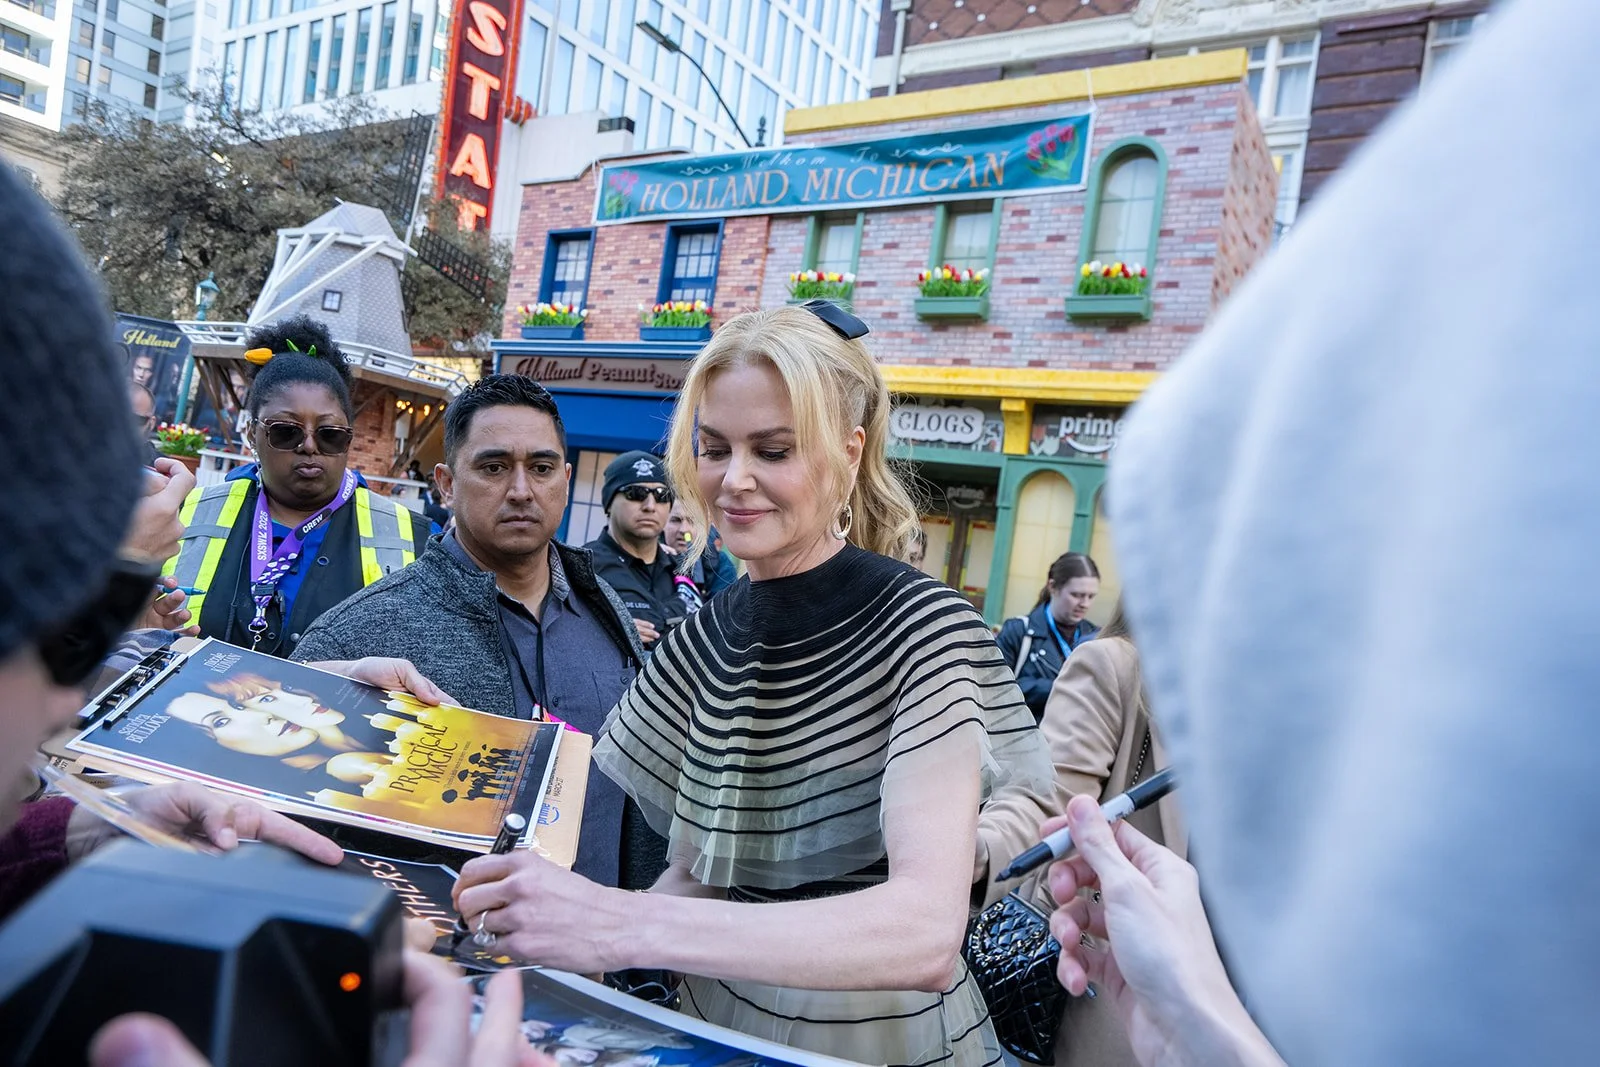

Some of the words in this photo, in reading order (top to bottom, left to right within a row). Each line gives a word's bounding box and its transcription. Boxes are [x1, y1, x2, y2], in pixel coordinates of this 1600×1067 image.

[850, 146, 879, 163] To
[639, 169, 789, 212] HOLLAND
[801, 150, 1010, 202] MICHIGAN
[123, 329, 180, 348] Holland
[516, 356, 588, 380] Holland
[587, 362, 656, 383] Peanut
[897, 411, 976, 435] CLOGS
[1059, 412, 1125, 439] prime
[947, 484, 985, 500] prime
[258, 510, 268, 531] 2025
[302, 514, 323, 533] CREW
[118, 713, 151, 736] sandra
[125, 713, 171, 743] BULLOCK
[389, 723, 448, 793] PRACTICAL
[421, 742, 458, 783] MAGIC
[537, 802, 550, 825] prime
